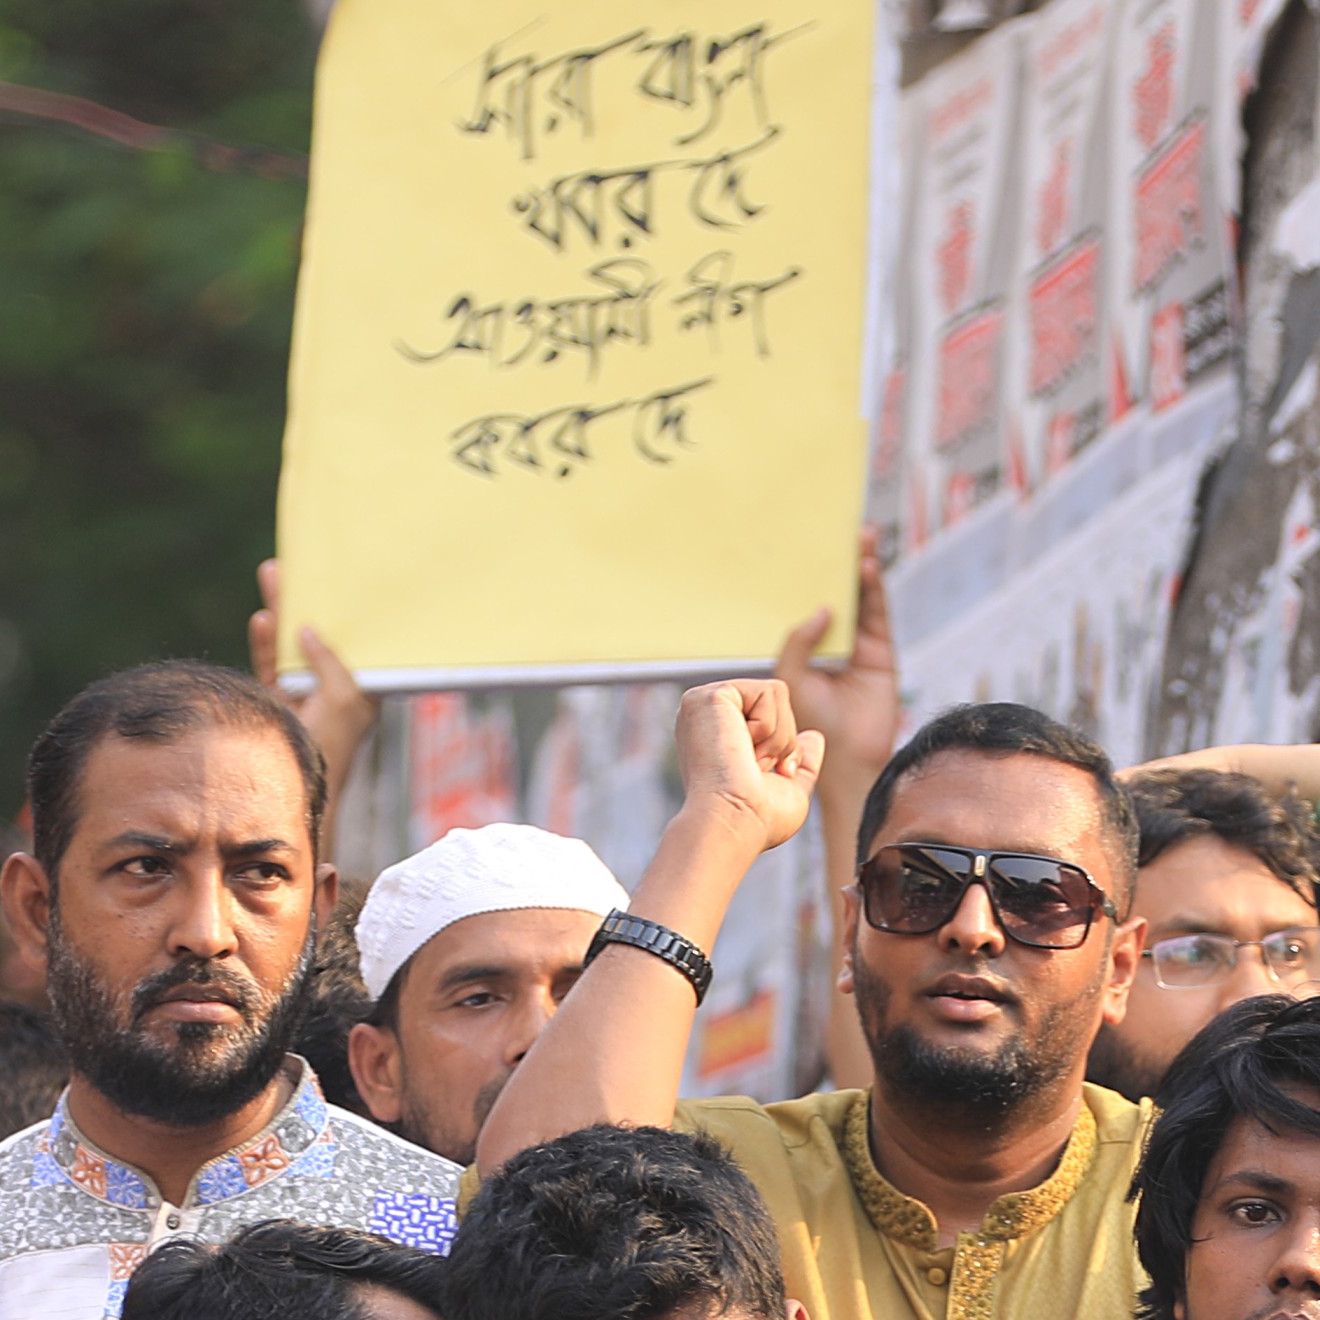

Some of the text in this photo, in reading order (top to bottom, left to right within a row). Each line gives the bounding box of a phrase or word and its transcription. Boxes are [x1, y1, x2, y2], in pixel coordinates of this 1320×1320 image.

[511, 127, 781, 253] খবর দে
[448, 376, 717, 480] কবর দে
